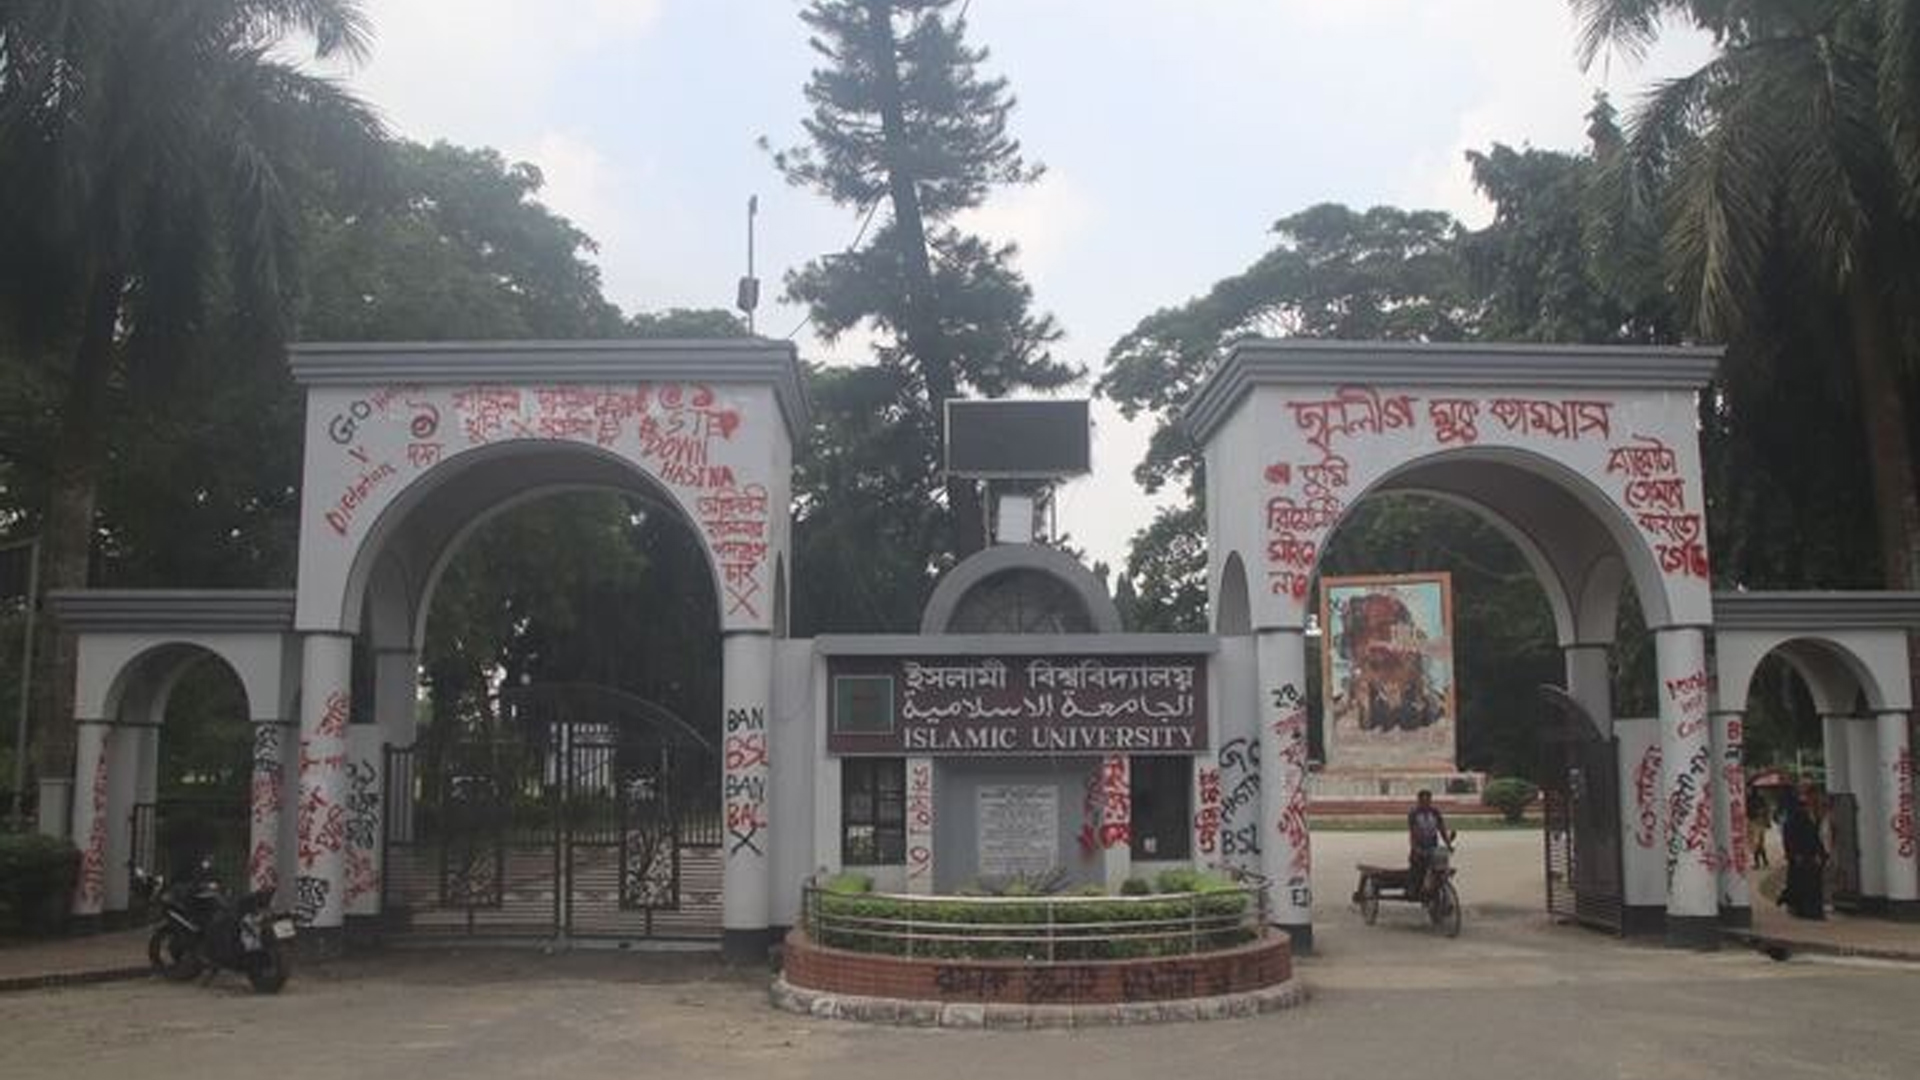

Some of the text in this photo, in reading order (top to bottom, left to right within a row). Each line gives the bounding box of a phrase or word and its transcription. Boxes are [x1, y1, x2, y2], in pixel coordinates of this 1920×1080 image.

[650, 434, 708, 466] DOWN
[660, 460, 736, 488] HASINA
[903, 657, 1195, 693] ইসলামী বিশ্ববিদ্যালয়
[727, 708, 764, 732] BAN
[1060, 688, 1194, 722] الجامعة
[904, 727, 1195, 749] ISLAMIC UNIVERSITY
[1221, 824, 1261, 855] BSL
